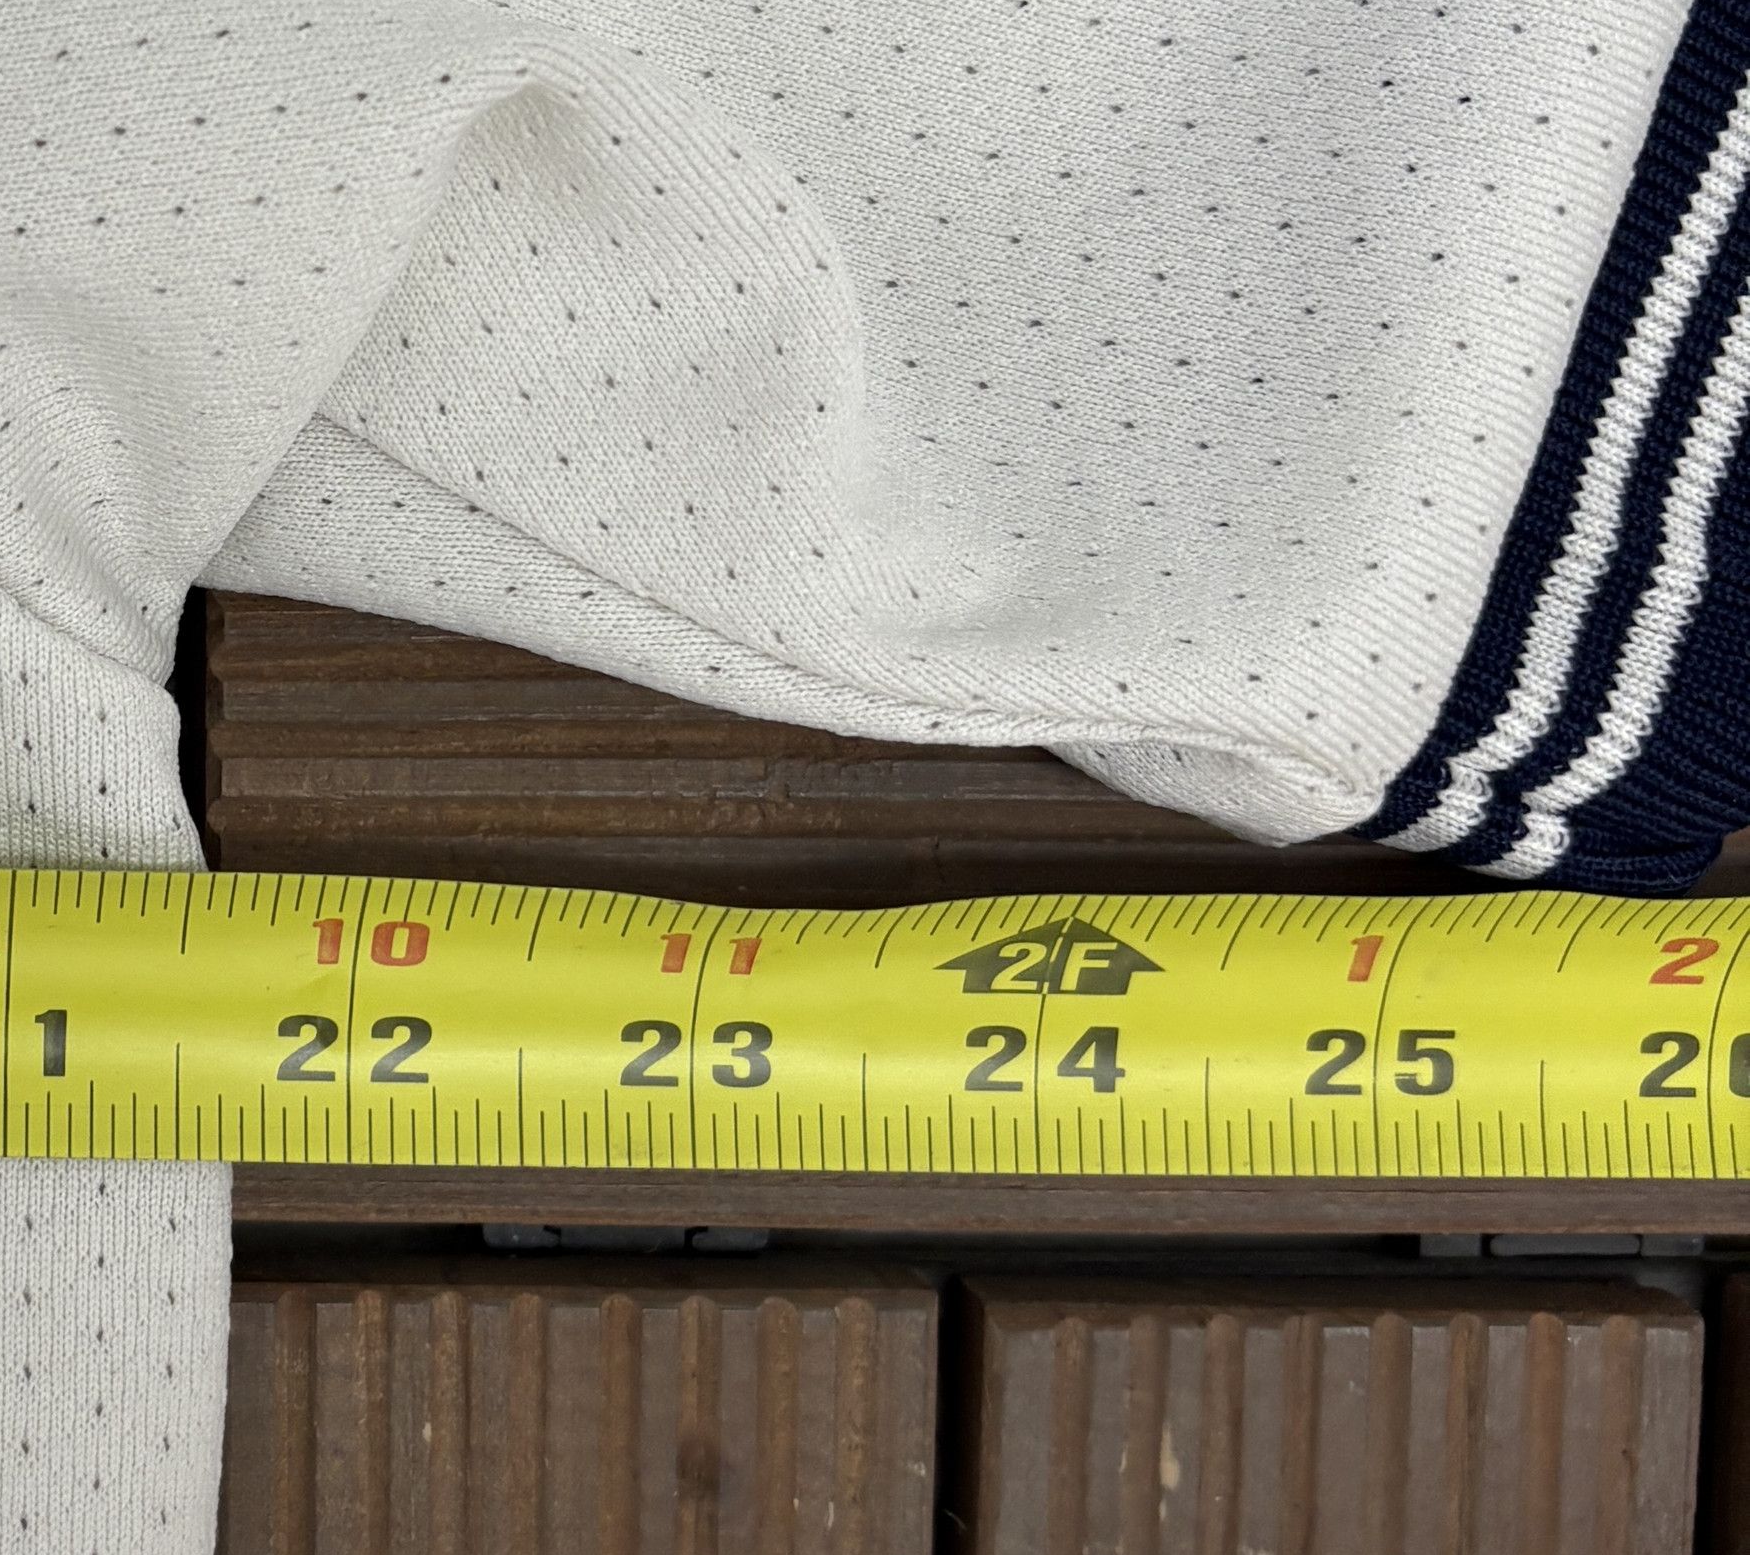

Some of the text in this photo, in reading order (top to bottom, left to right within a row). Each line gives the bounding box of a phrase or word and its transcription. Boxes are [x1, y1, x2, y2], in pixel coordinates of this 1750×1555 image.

[311, 918, 430, 967] 10
[659, 933, 763, 975] 11
[991, 942, 1117, 991] 2F
[1346, 935, 1384, 982] 1
[1649, 938, 1720, 984] 2
[276, 1015, 434, 1083] 22
[619, 1020, 773, 1088] 23
[964, 1026, 1126, 1093] 24
[1305, 1029, 1456, 1096] 25
